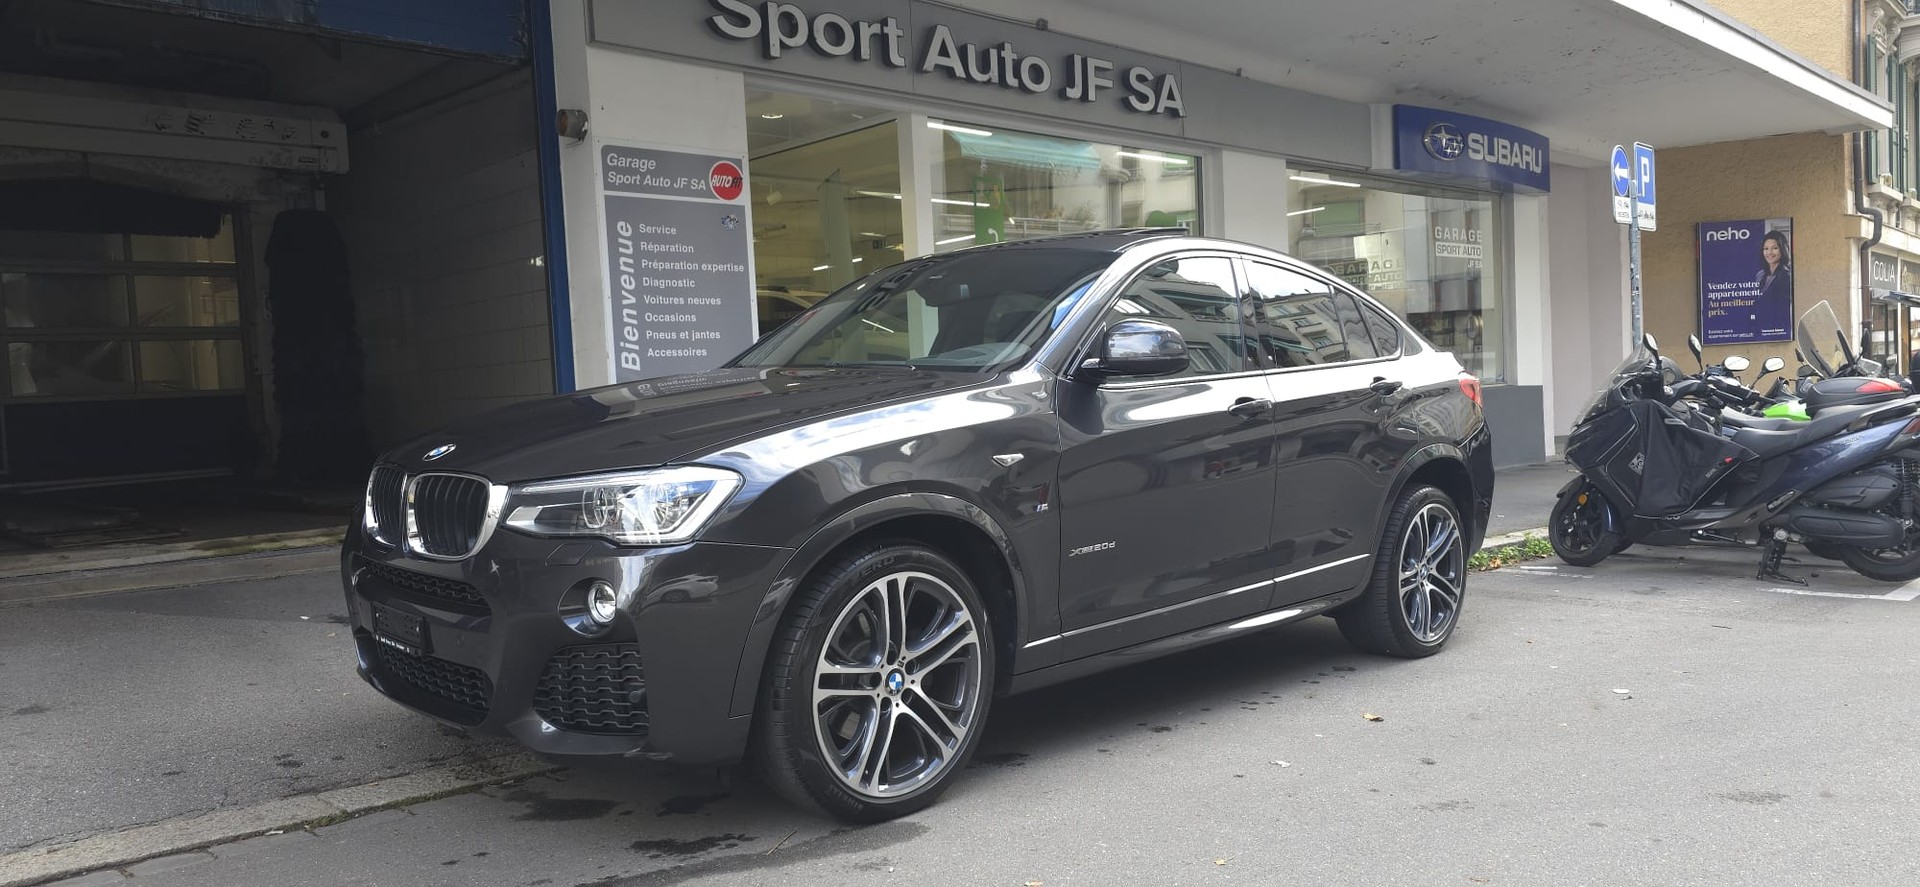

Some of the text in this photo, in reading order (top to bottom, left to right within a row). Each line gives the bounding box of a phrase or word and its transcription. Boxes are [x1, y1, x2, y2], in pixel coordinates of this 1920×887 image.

[709, 0, 1187, 117] Sport Auto JF SA
[1467, 132, 1543, 174] SUBARU
[606, 153, 657, 173] Garage
[607, 171, 707, 191] Sport Auto JF SA
[1640, 156, 1650, 198] P
[638, 223, 677, 235] Service
[1434, 225, 1482, 242] GARAGE
[1706, 226, 1751, 242] neho
[640, 241, 694, 254] Réparation
[1436, 244, 1482, 257] SPORT AUTO
[641, 259, 745, 272] Préparation expertise
[642, 277, 696, 288] Diagnostic
[1707, 281, 1761, 291] Vendez votre
[616, 220, 641, 371] Bienvenue
[643, 294, 722, 305] Voitures neuves
[1707, 289, 1764, 300] appartement.
[1708, 297, 1756, 309] Au meilleur
[644, 312, 697, 322] Occasions
[1708, 308, 1729, 319] prix.
[646, 330, 721, 341] Pneus et jantes
[647, 347, 708, 358] Accessoires
